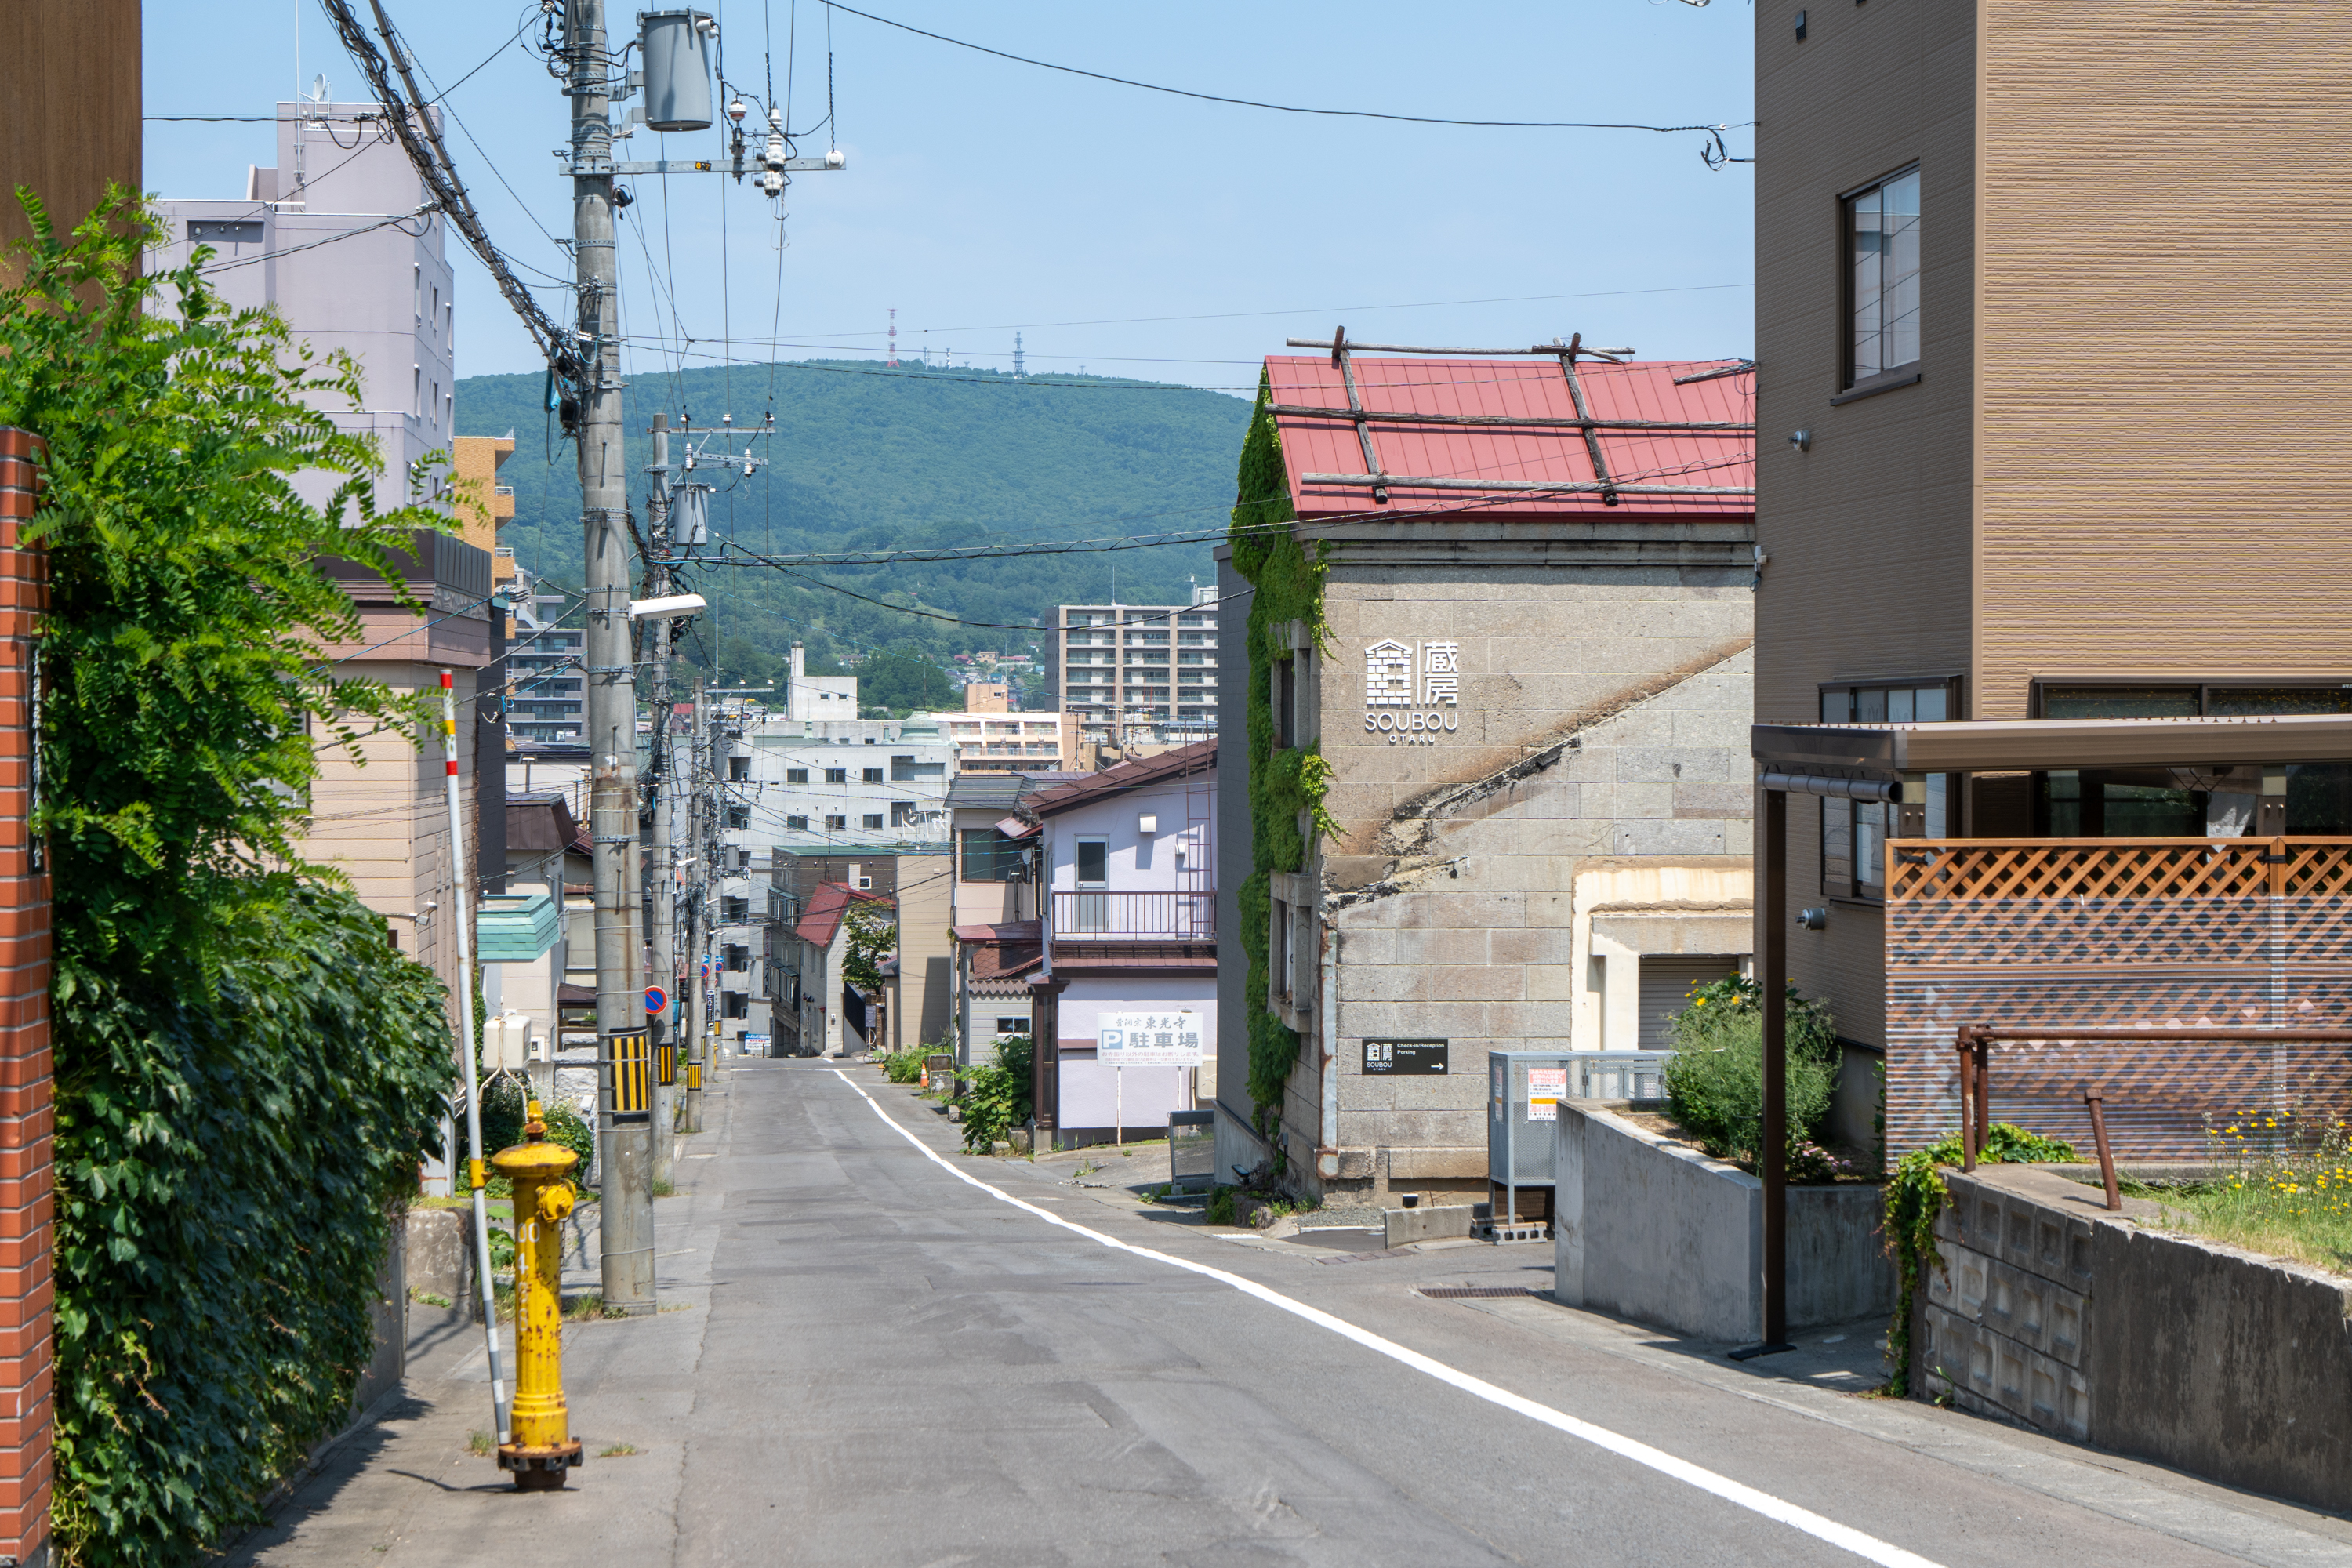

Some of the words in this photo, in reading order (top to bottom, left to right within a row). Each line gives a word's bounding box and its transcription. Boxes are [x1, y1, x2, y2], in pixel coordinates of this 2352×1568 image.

[1425, 641, 1459, 704] 蔵房
[1364, 712, 1458, 731] SOUBOU
[1388, 734, 1436, 742] OTARU
[1145, 1015, 1186, 1029] 東光寺
[1103, 1031, 1122, 1048] P
[1129, 1032, 1199, 1048] 駐車場
